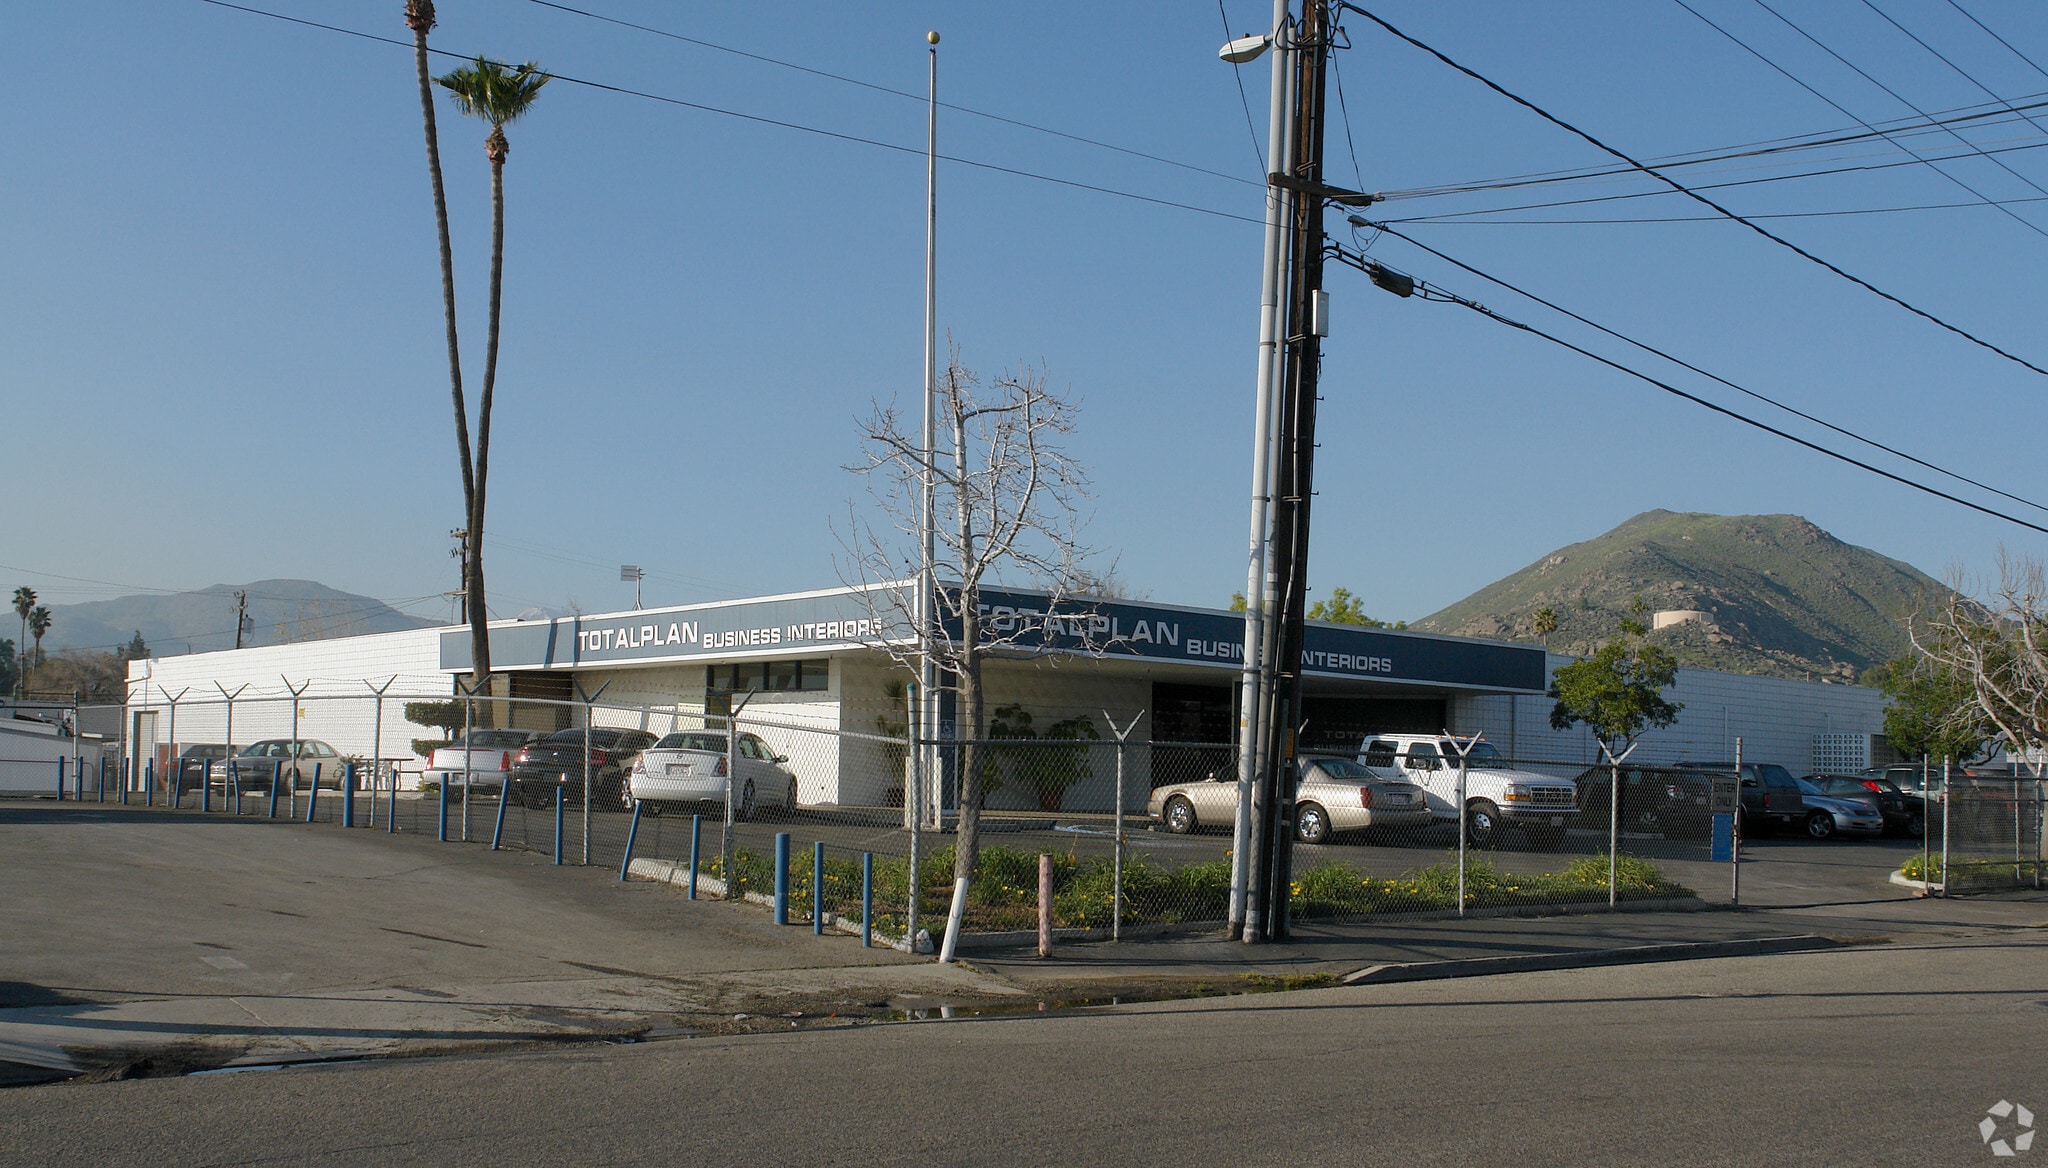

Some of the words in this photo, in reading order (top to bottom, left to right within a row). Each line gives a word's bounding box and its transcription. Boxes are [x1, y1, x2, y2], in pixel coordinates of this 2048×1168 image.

[579, 621, 699, 652] TOTALPLAN
[703, 627, 781, 649] BUSINESS
[787, 617, 882, 642] INTERIORS
[1187, 639, 1262, 660] BUSIN
[1300, 649, 1392, 673] NTERIORS
[1714, 782, 1736, 793] ENTER
[1715, 796, 1733, 807] ONLY
